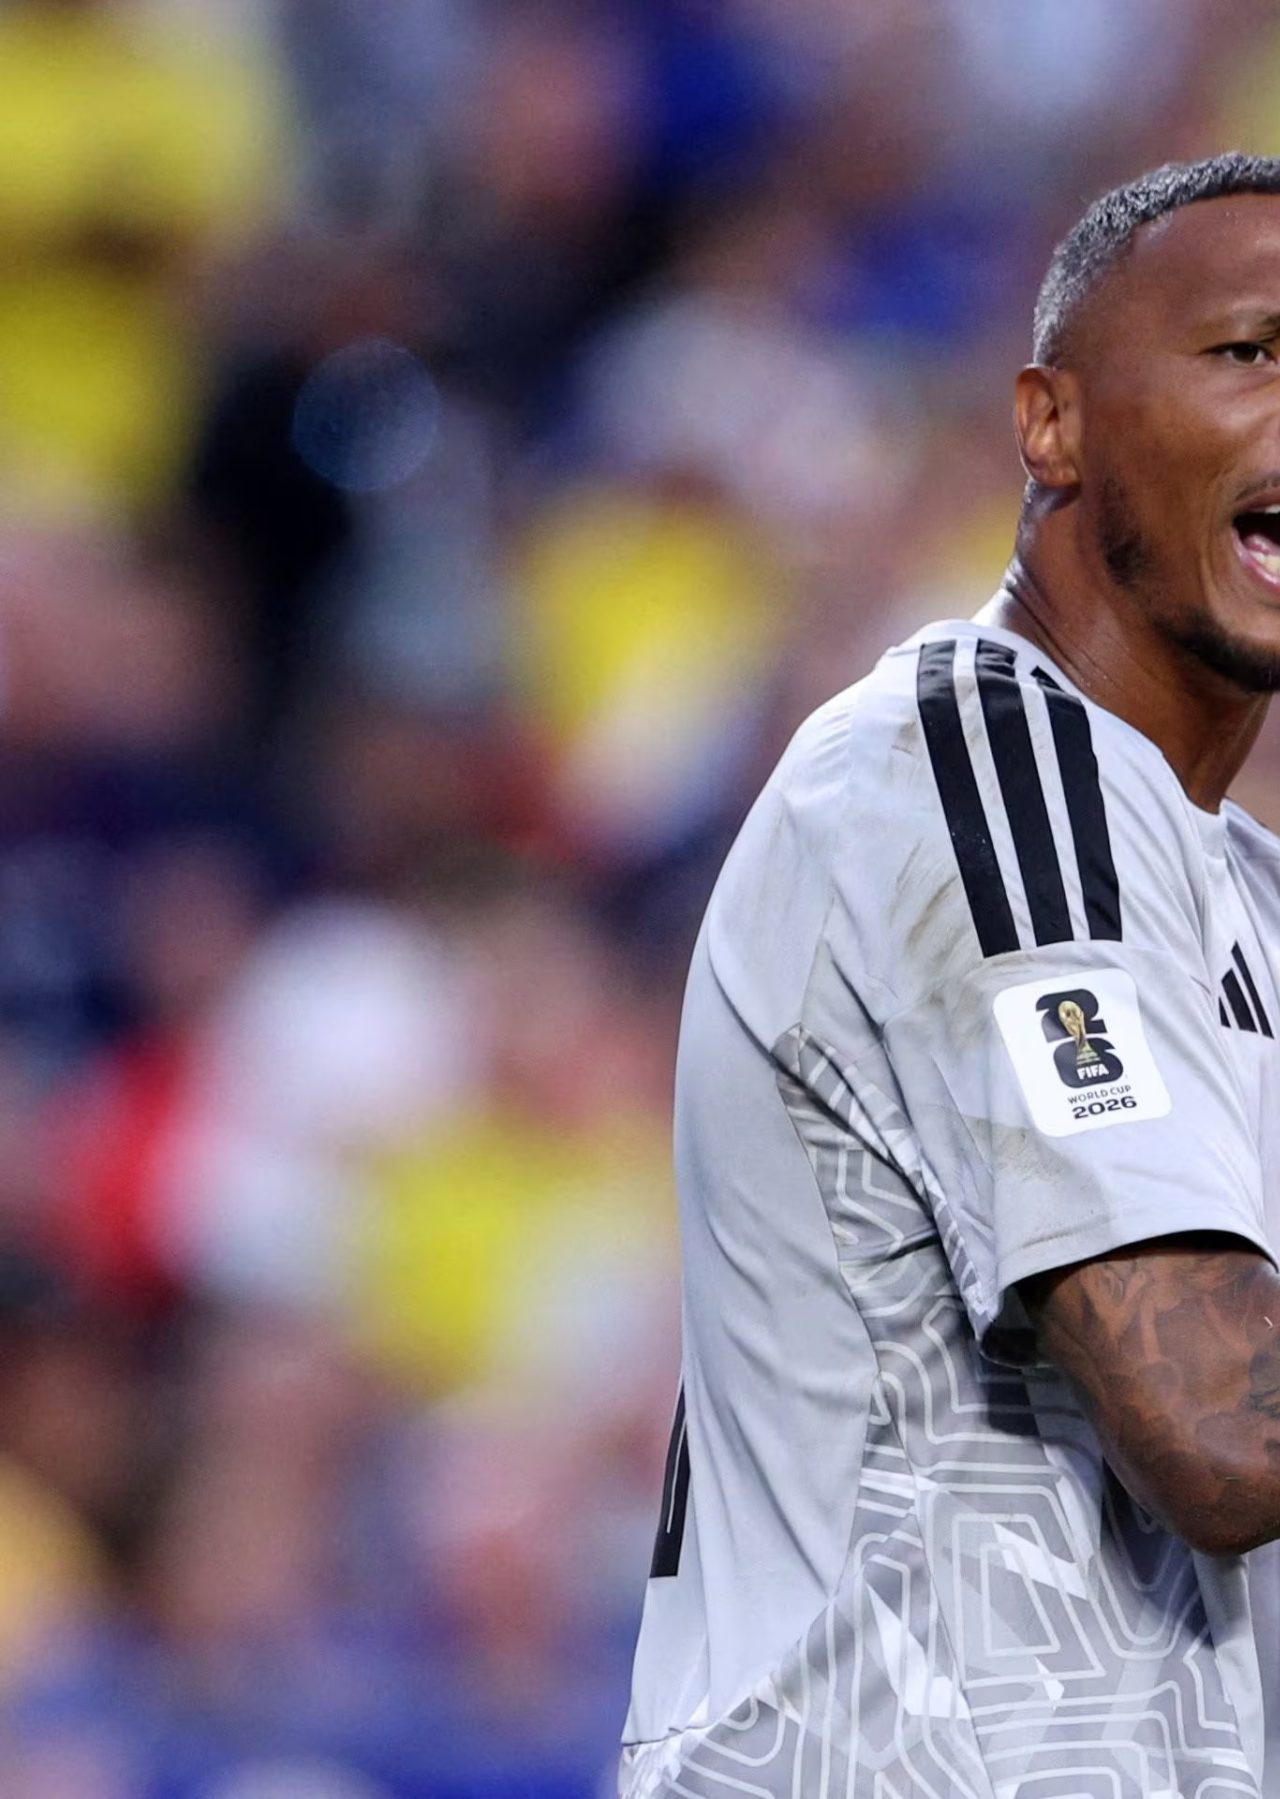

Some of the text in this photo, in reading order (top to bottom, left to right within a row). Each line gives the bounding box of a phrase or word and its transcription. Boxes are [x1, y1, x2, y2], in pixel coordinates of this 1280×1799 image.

[1076, 1064, 1109, 1079] FIFA
[1067, 1084, 1132, 1104] WORLD CUP
[1072, 1095, 1137, 1119] 2026
